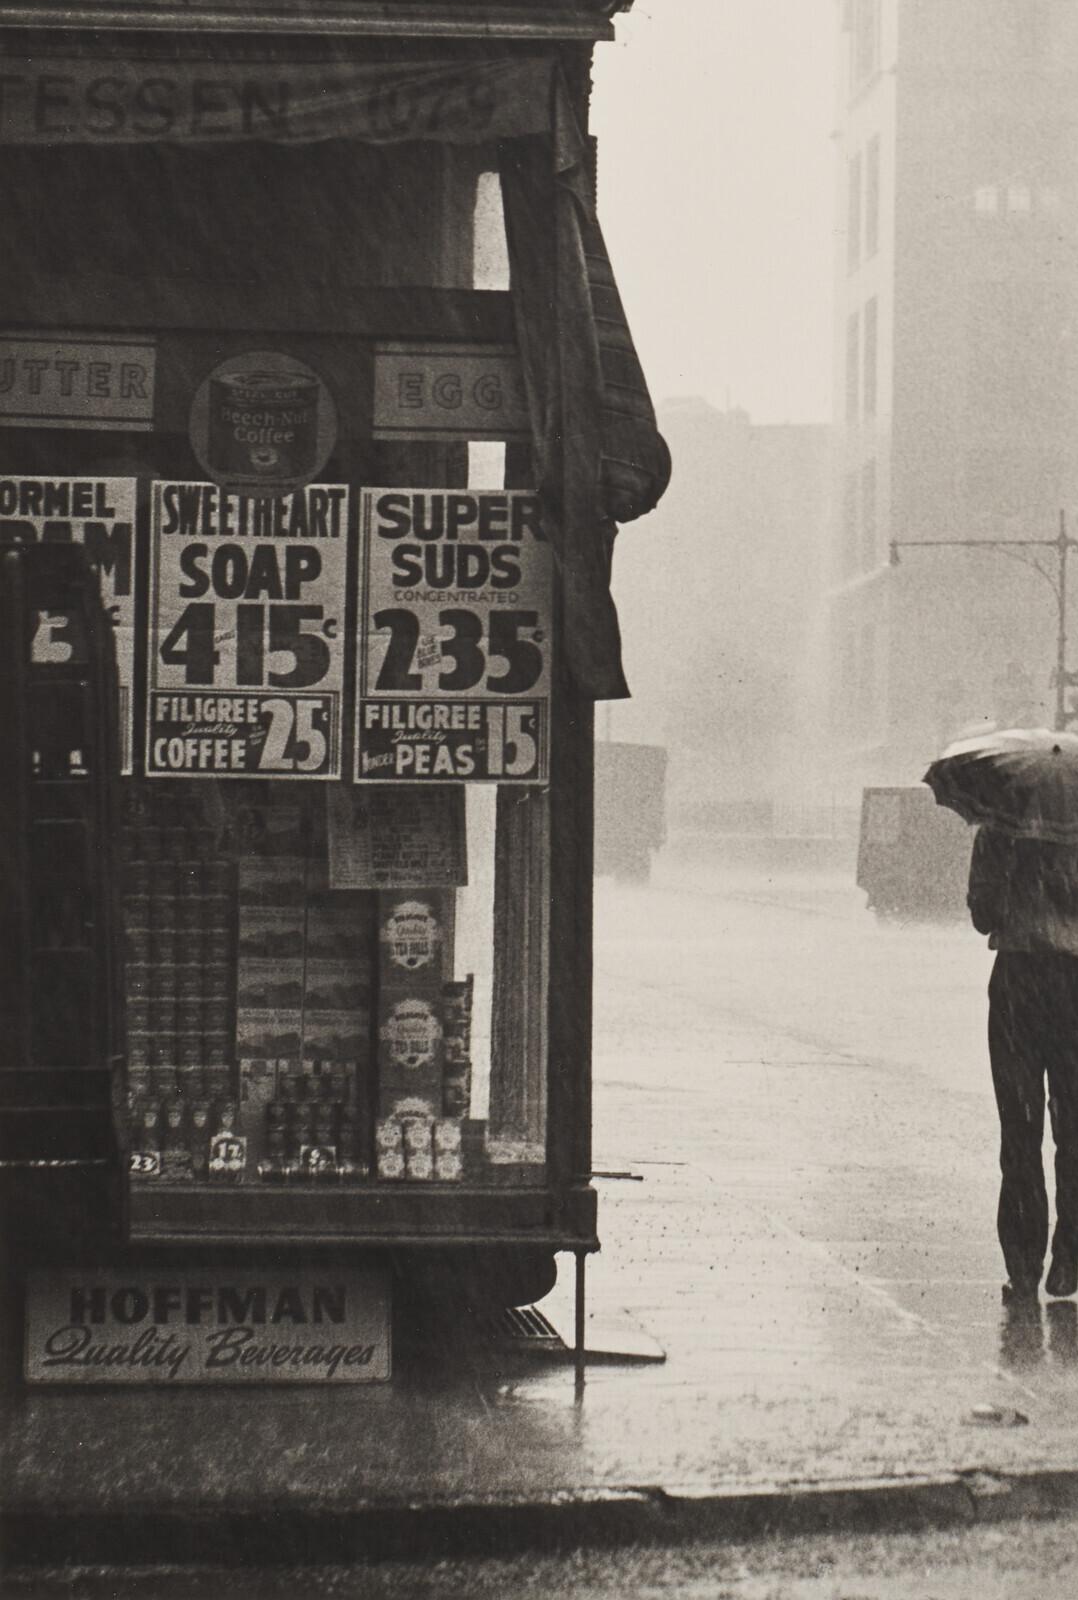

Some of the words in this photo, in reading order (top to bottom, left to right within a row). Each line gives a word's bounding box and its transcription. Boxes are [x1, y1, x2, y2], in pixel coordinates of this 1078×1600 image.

[233, 426, 295, 445] Coffee
[162, 485, 348, 538] SWEETHEART
[376, 494, 547, 542] SUPER
[178, 543, 322, 600] SOAP
[391, 544, 522, 590] SUDS
[393, 590, 519, 604] CONCENTRATED
[159, 603, 220, 685] 4
[373, 608, 423, 692] 2
[154, 697, 259, 723] FILIGREE
[365, 704, 481, 730] FILIGREE
[154, 738, 246, 769] COFFEE
[396, 744, 475, 776] PEAS
[70, 1286, 347, 1326] HOFFMAN
[43, 1326, 191, 1379] Quality
[205, 1326, 376, 1378] Beverages
